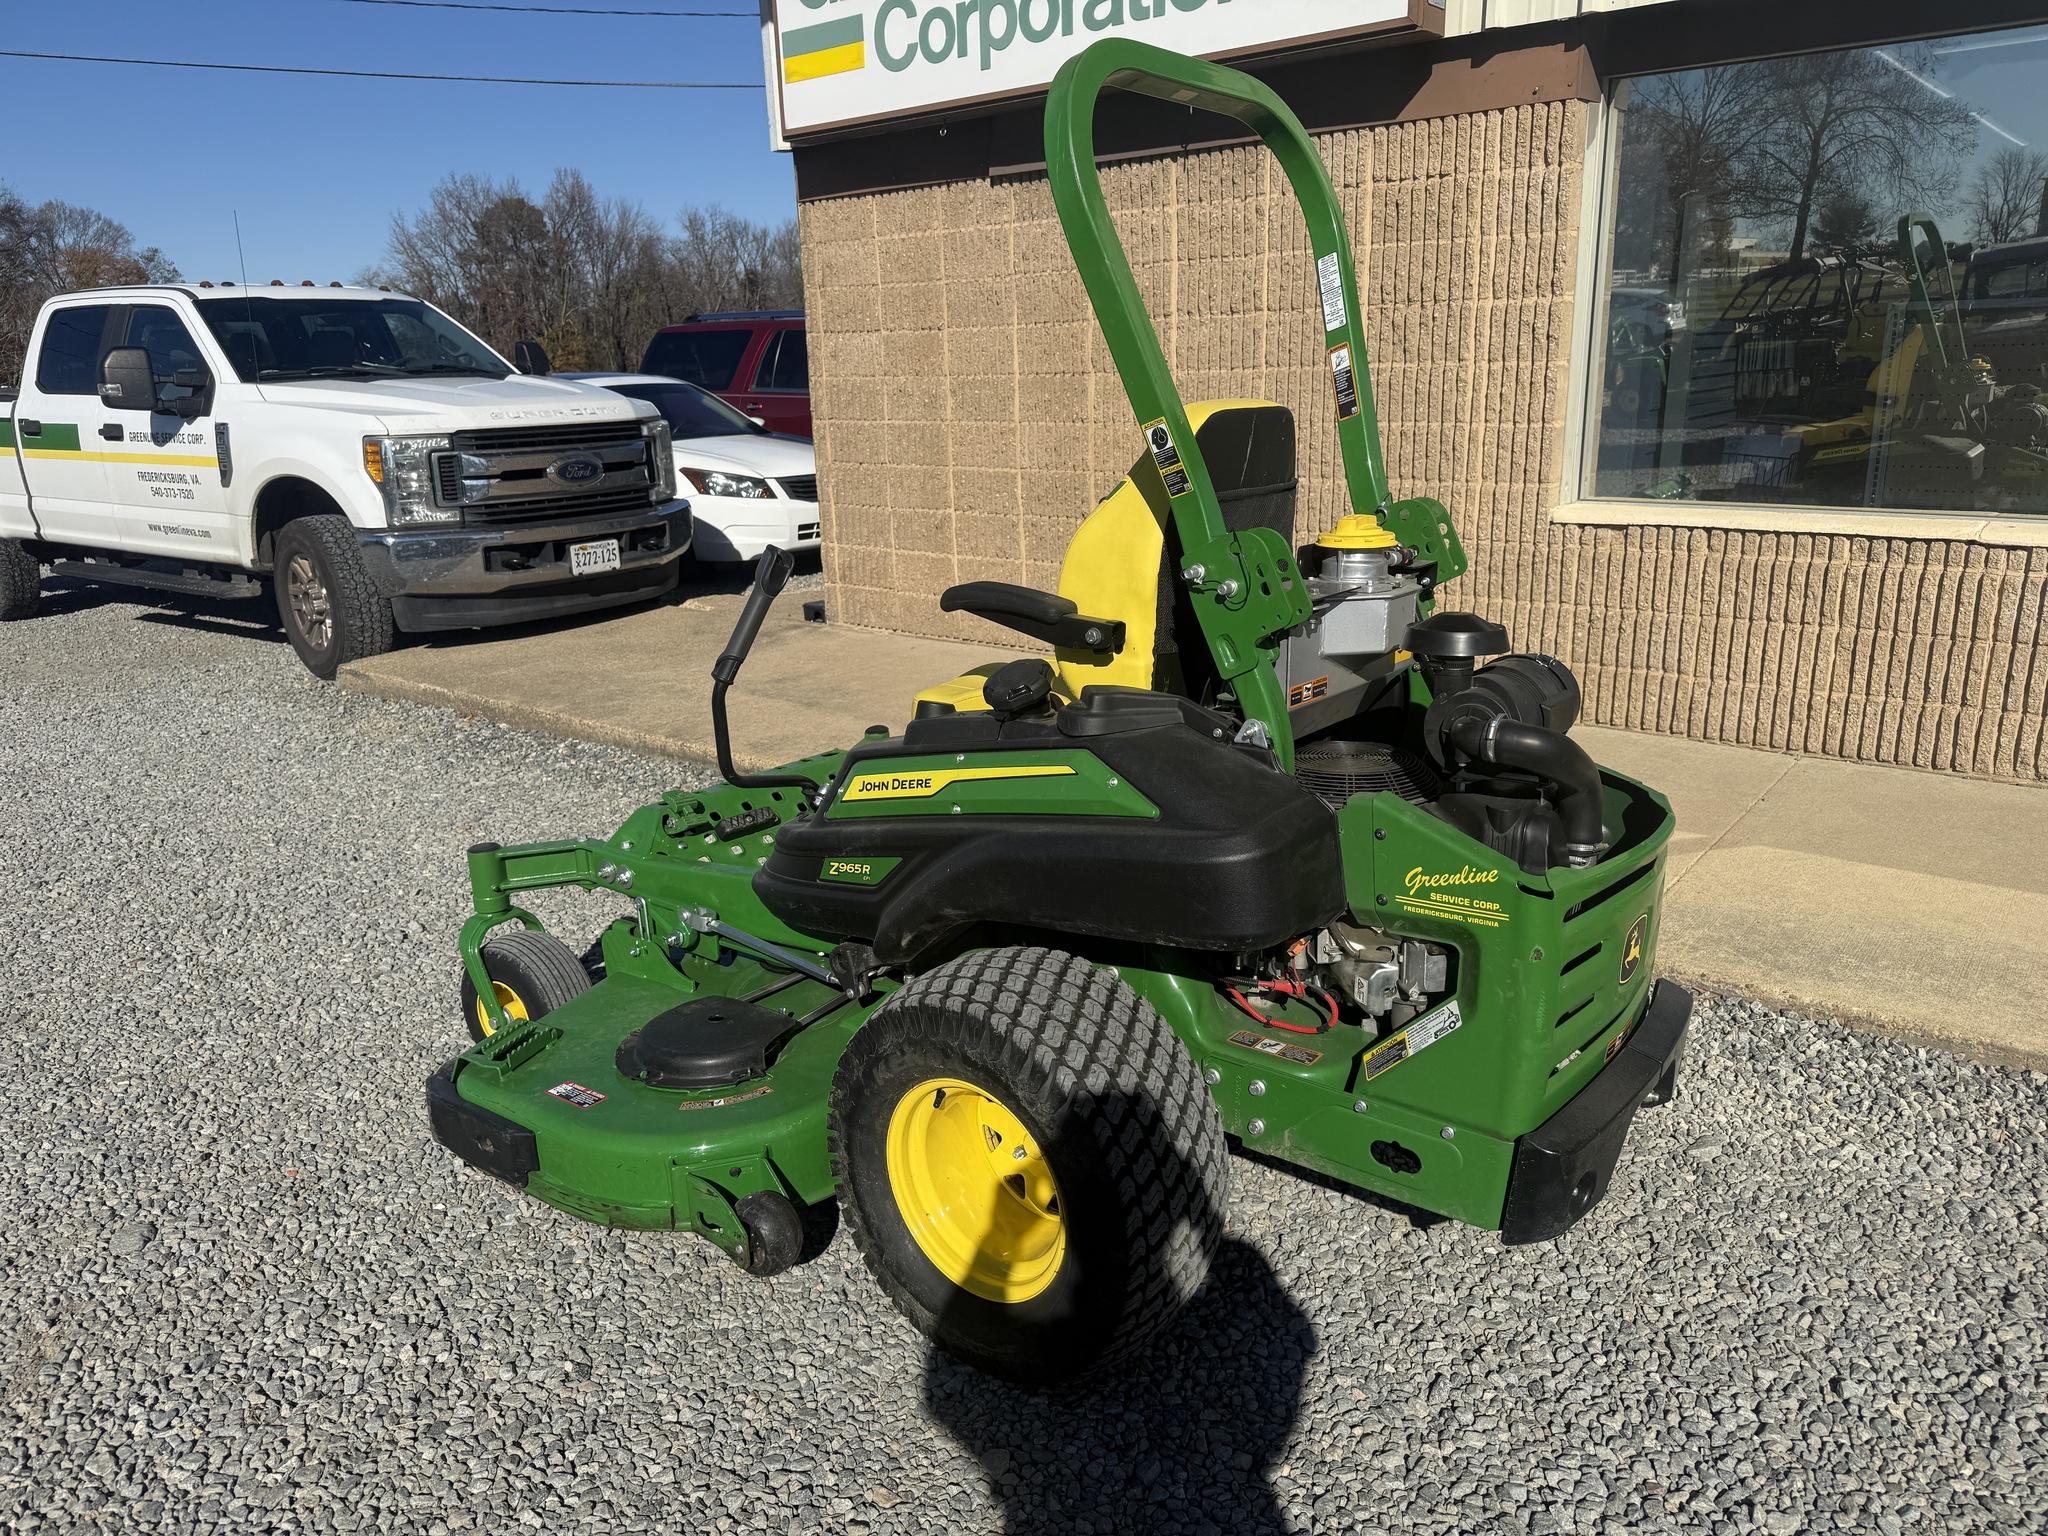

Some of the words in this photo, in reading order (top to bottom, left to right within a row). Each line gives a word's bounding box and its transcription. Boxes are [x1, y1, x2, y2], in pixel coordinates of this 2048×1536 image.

[874, 0, 1232, 71] Corpora
[490, 410, 568, 420] SUPER
[570, 406, 620, 416] DUTY
[128, 431, 160, 443] GREENLINE
[161, 432, 186, 444] SERVICE
[187, 433, 207, 445] CORP.
[566, 463, 592, 478] Ford
[137, 471, 190, 486] FREDERICKSBURG,
[190, 474, 202, 486] VA.
[150, 486, 195, 500] 540-373-7520
[147, 523, 212, 539] www.greenlineva.com
[858, 780, 889, 793] JOHN
[891, 778, 932, 791] DEERE
[829, 861, 871, 875] Z965R
[1404, 864, 1499, 896] Greenline
[1430, 892, 1471, 906] SERVICE
[1473, 899, 1502, 912] CORP.
[1403, 905, 1466, 922] FREDERICKSBURG,
[1467, 916, 1500, 928] VIRGINIA
